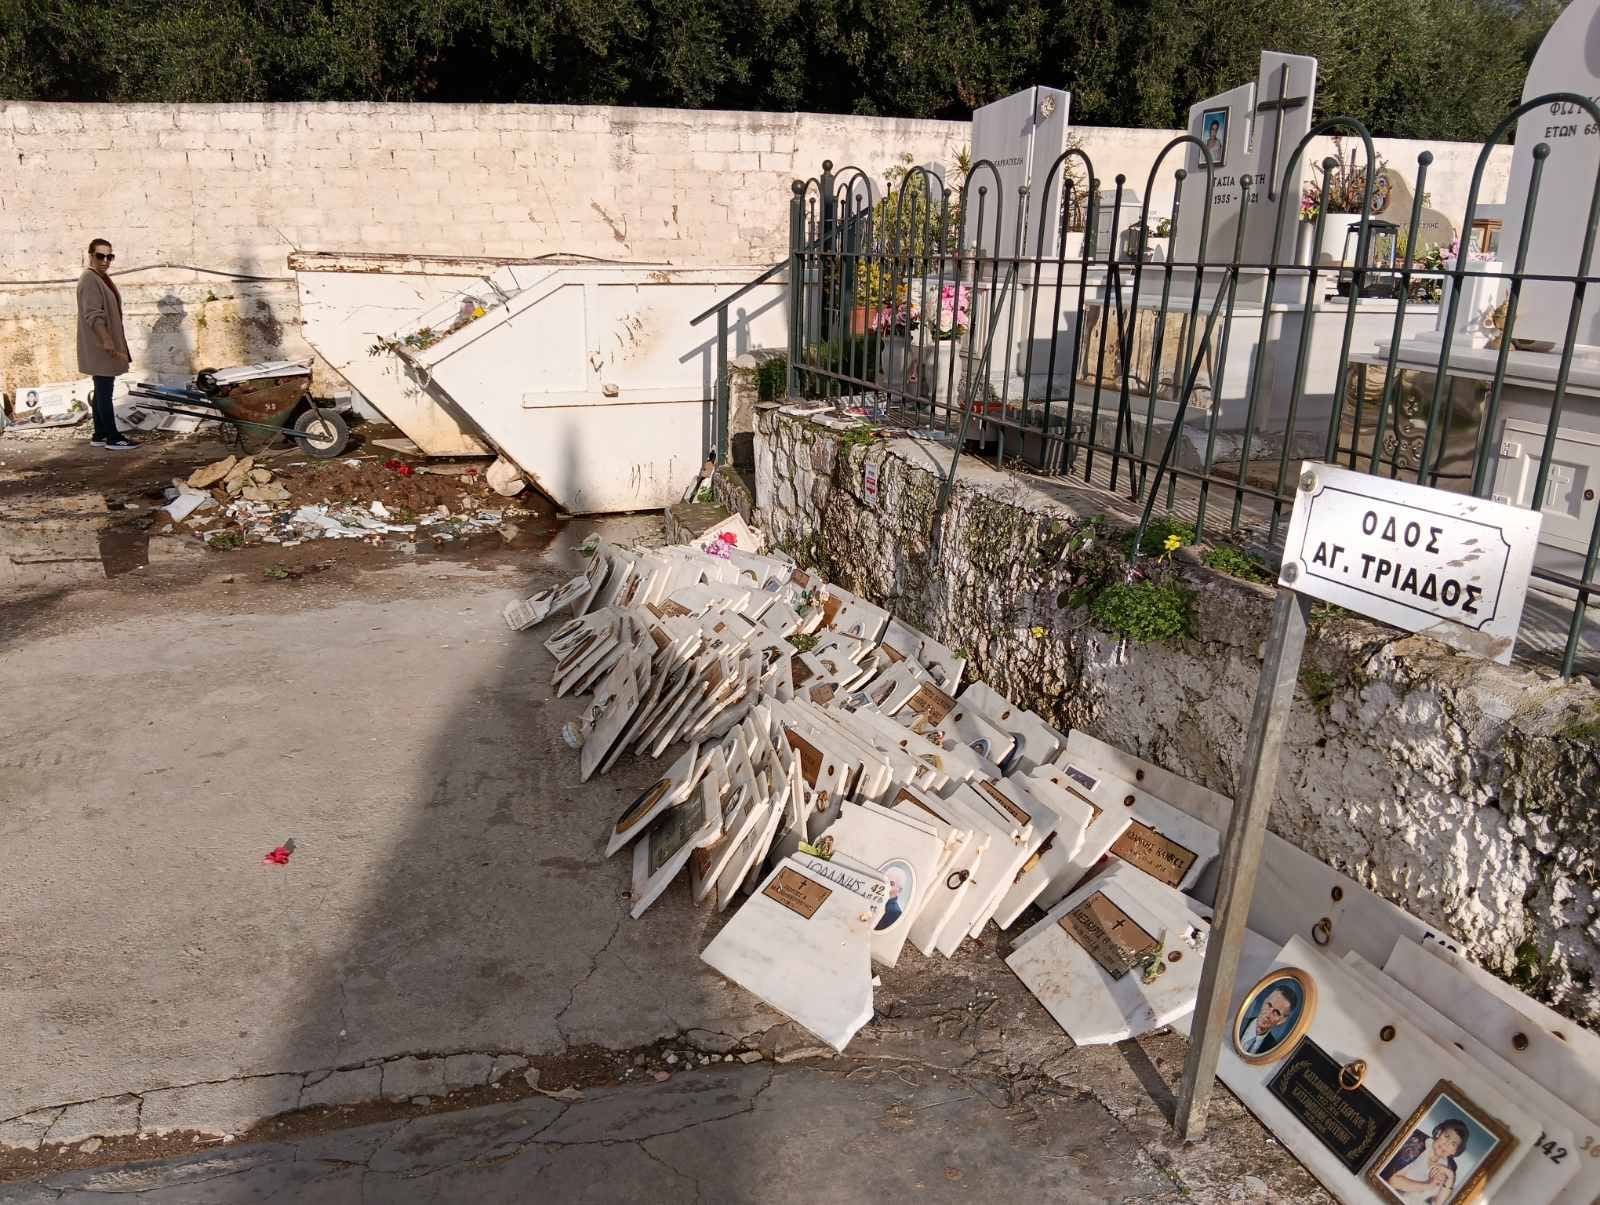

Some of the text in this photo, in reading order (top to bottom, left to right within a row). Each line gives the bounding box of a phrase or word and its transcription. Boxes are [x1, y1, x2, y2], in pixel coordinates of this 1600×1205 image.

[1544, 124, 1577, 138] ΕΤΩΝ
[1362, 509, 1443, 555] ΟΔΟΣ
[1312, 541, 1483, 615] ΑΓ. ΤΡΙΑΔΟΣ
